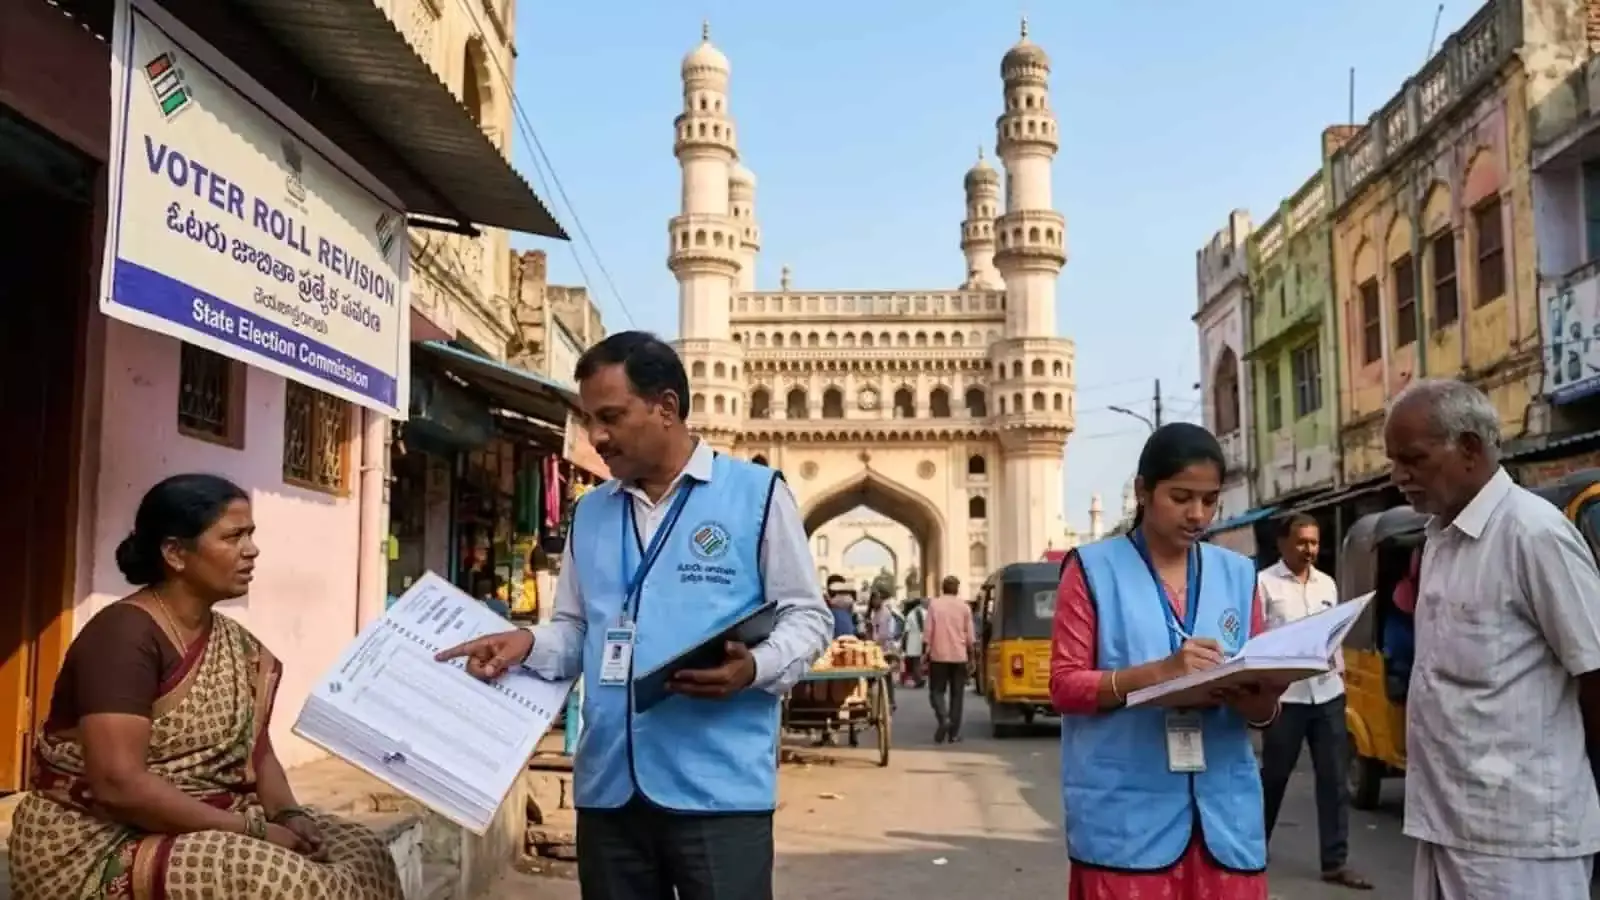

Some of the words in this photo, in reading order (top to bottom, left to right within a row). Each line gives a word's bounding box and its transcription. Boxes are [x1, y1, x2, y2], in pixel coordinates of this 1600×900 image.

[144, 134, 245, 220] VOTER
[253, 196, 311, 256] ROLL
[318, 236, 395, 306] REVISION
[232, 239, 295, 283] జాబితా
[192, 298, 234, 334] State
[238, 316, 296, 359] Election
[299, 343, 369, 389] Commission
